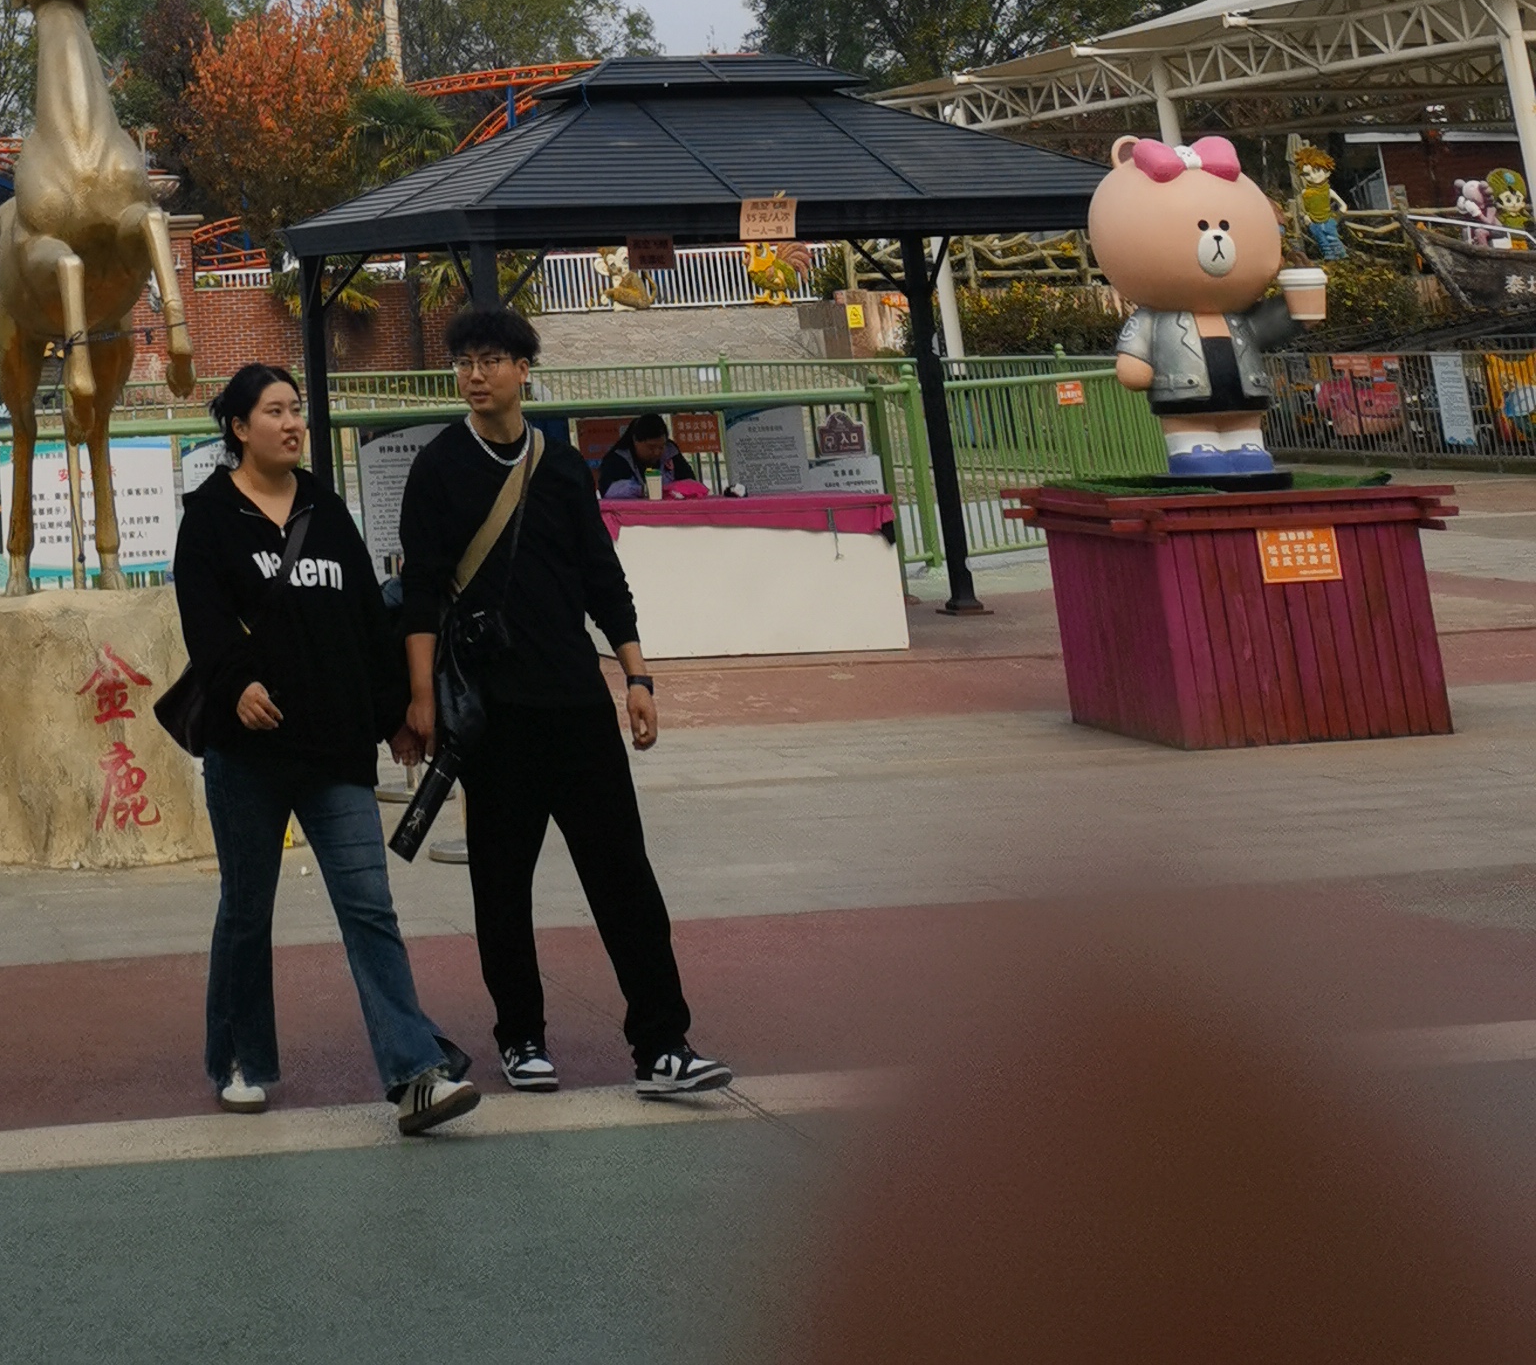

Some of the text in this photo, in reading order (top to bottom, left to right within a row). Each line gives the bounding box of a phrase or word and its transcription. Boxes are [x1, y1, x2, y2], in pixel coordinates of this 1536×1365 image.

[839, 431, 859, 445] 入口
[251, 550, 344, 591] Wetern
[75, 641, 162, 833] 金鹿
